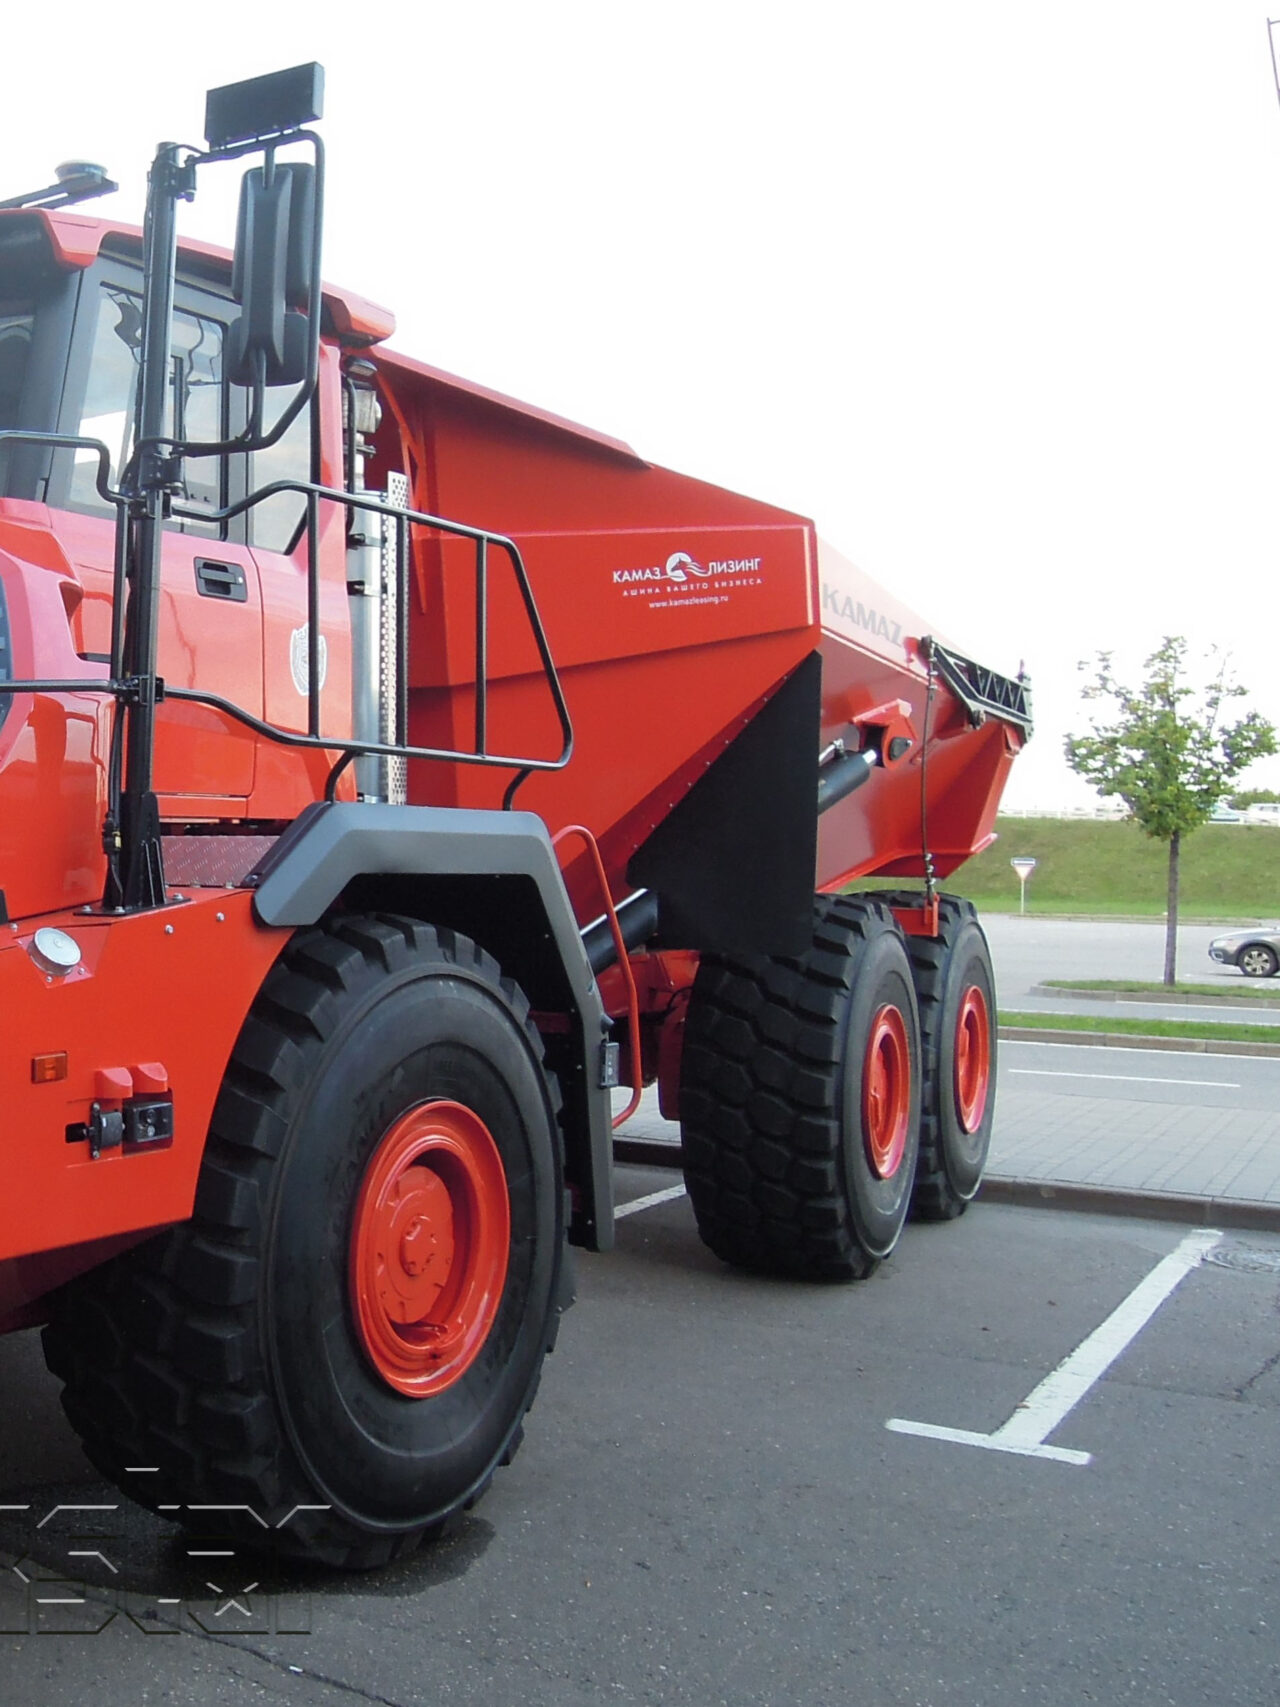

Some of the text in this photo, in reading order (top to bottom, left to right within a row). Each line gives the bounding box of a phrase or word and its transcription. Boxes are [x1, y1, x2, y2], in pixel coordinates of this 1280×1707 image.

[612, 558, 761, 583] КАМАЗ ЛИЗИНГ
[666, 582, 709, 593] ВАШЕГО
[714, 578, 763, 588] БИЗНЕСА
[648, 595, 729, 608] www.kamazleasing.ru
[822, 583, 902, 648] KAMAZ
